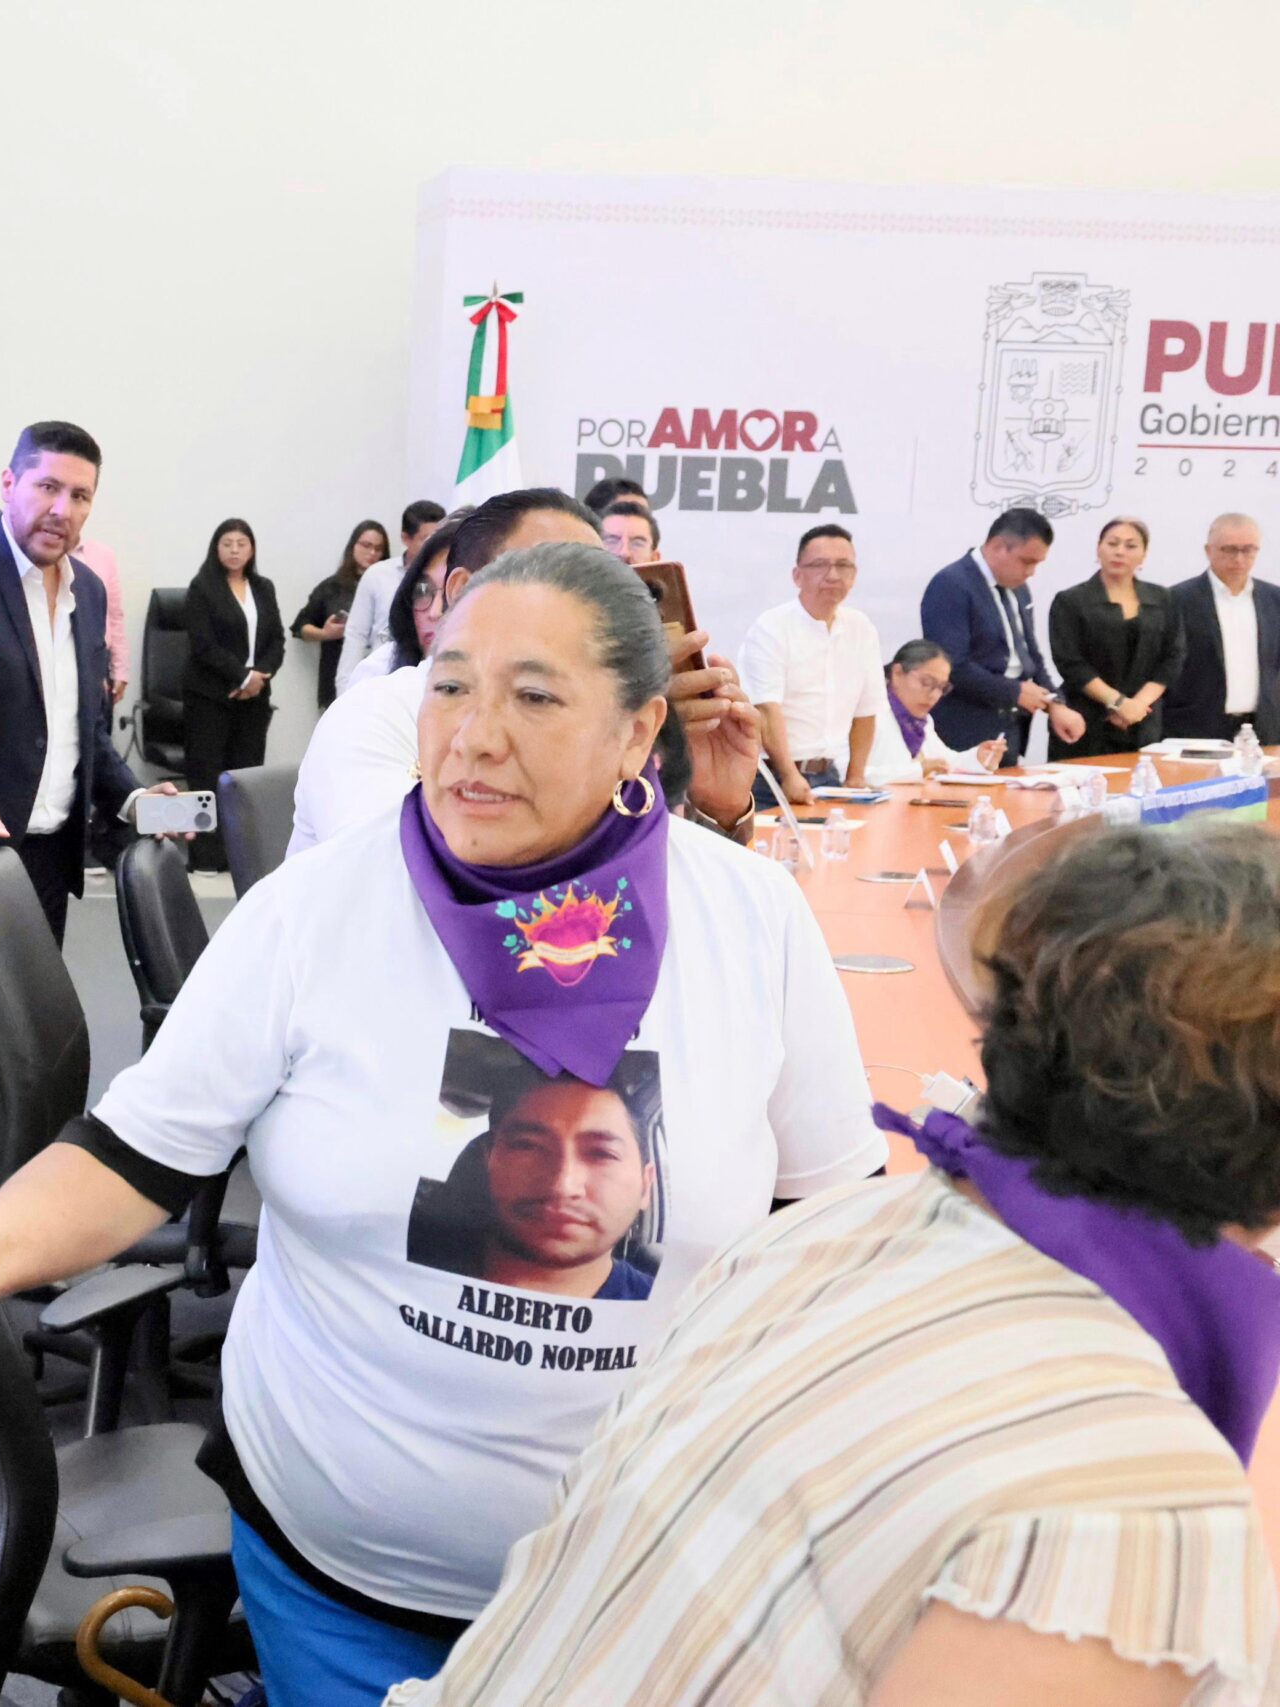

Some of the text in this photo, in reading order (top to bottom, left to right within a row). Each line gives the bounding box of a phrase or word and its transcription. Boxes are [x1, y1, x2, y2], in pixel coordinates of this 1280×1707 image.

[577, 407, 842, 453] POR AMOR A
[575, 453, 858, 514] PUEBLA
[457, 1285, 593, 1334] ALBERTO
[399, 1304, 638, 1372] GALLARDO NOPHAL
